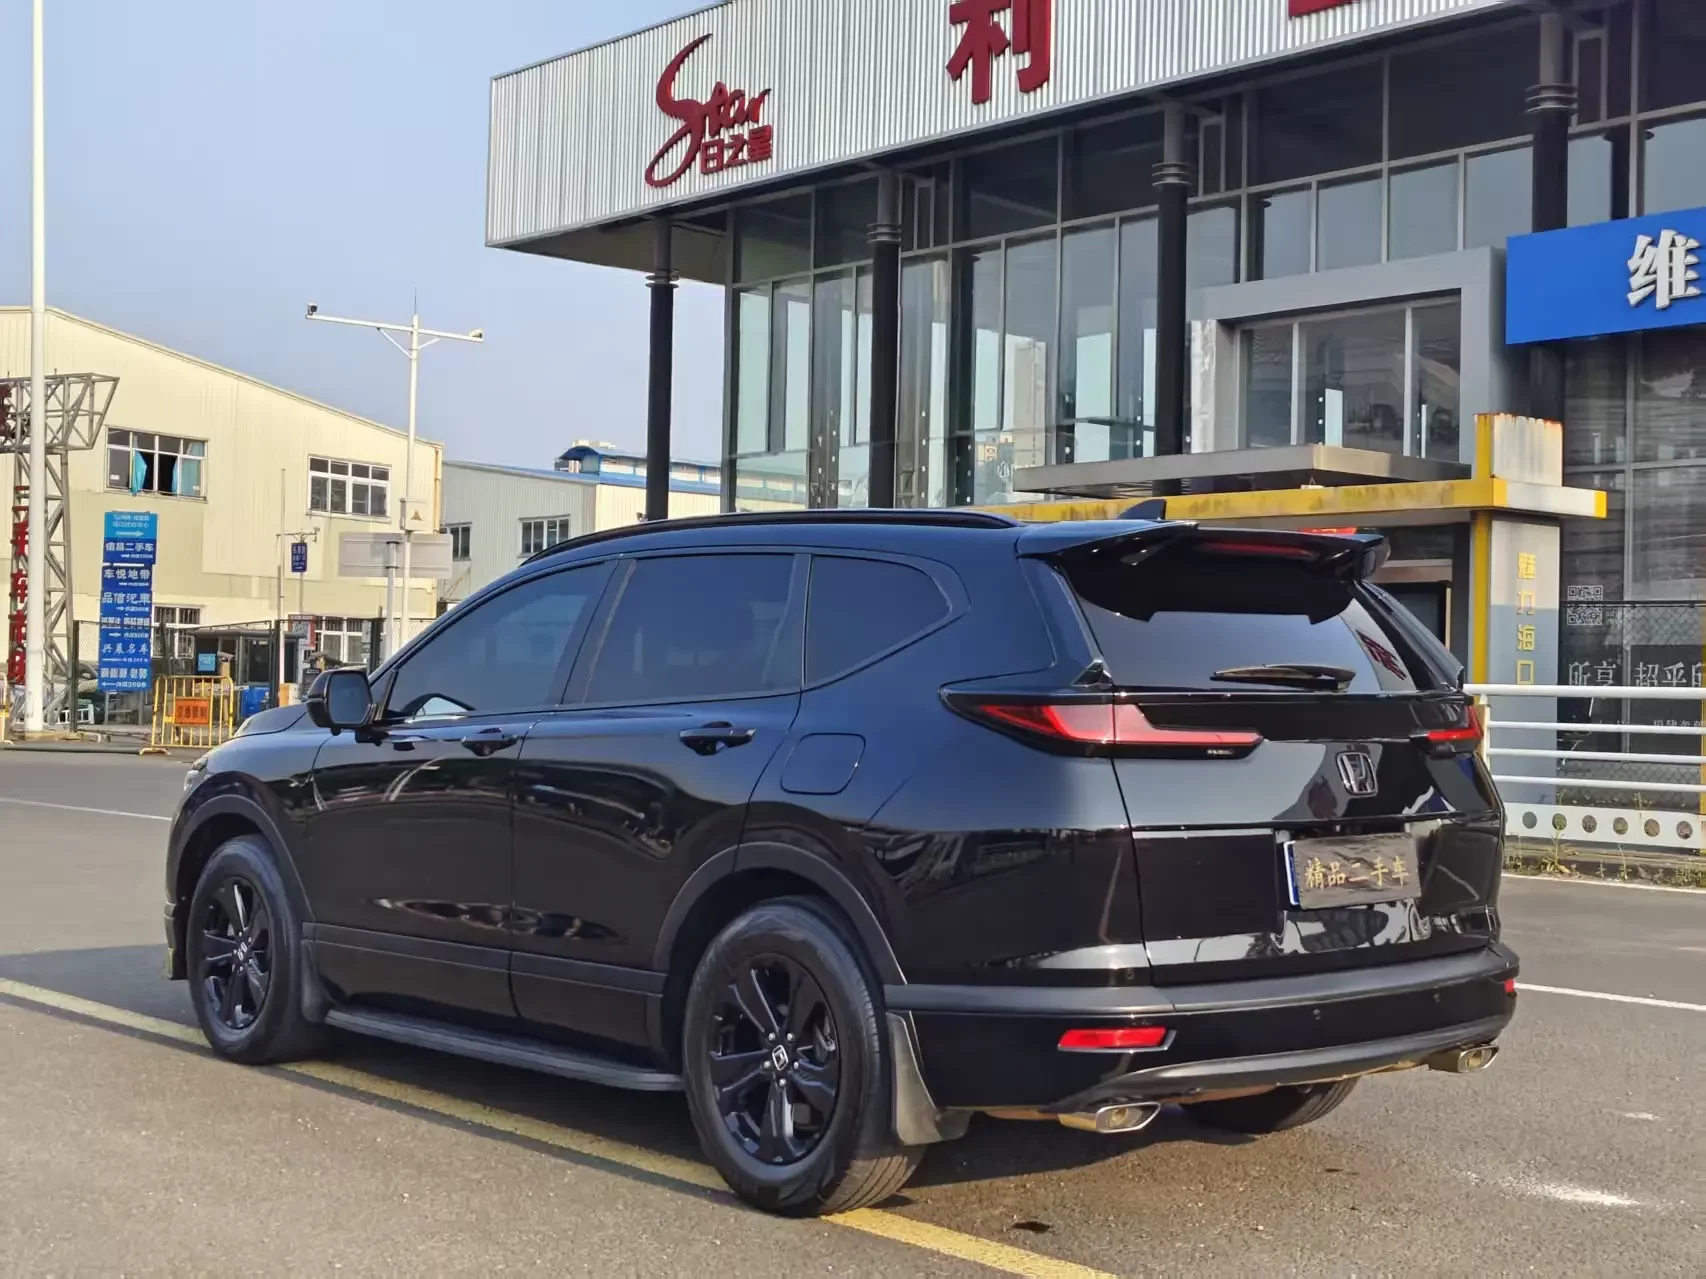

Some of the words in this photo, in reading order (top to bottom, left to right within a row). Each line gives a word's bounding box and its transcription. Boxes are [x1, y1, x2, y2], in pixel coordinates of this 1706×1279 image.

[645, 33, 772, 187] Star
[1626, 228, 1701, 310] 维
[1305, 855, 1410, 890] 精品二手车
